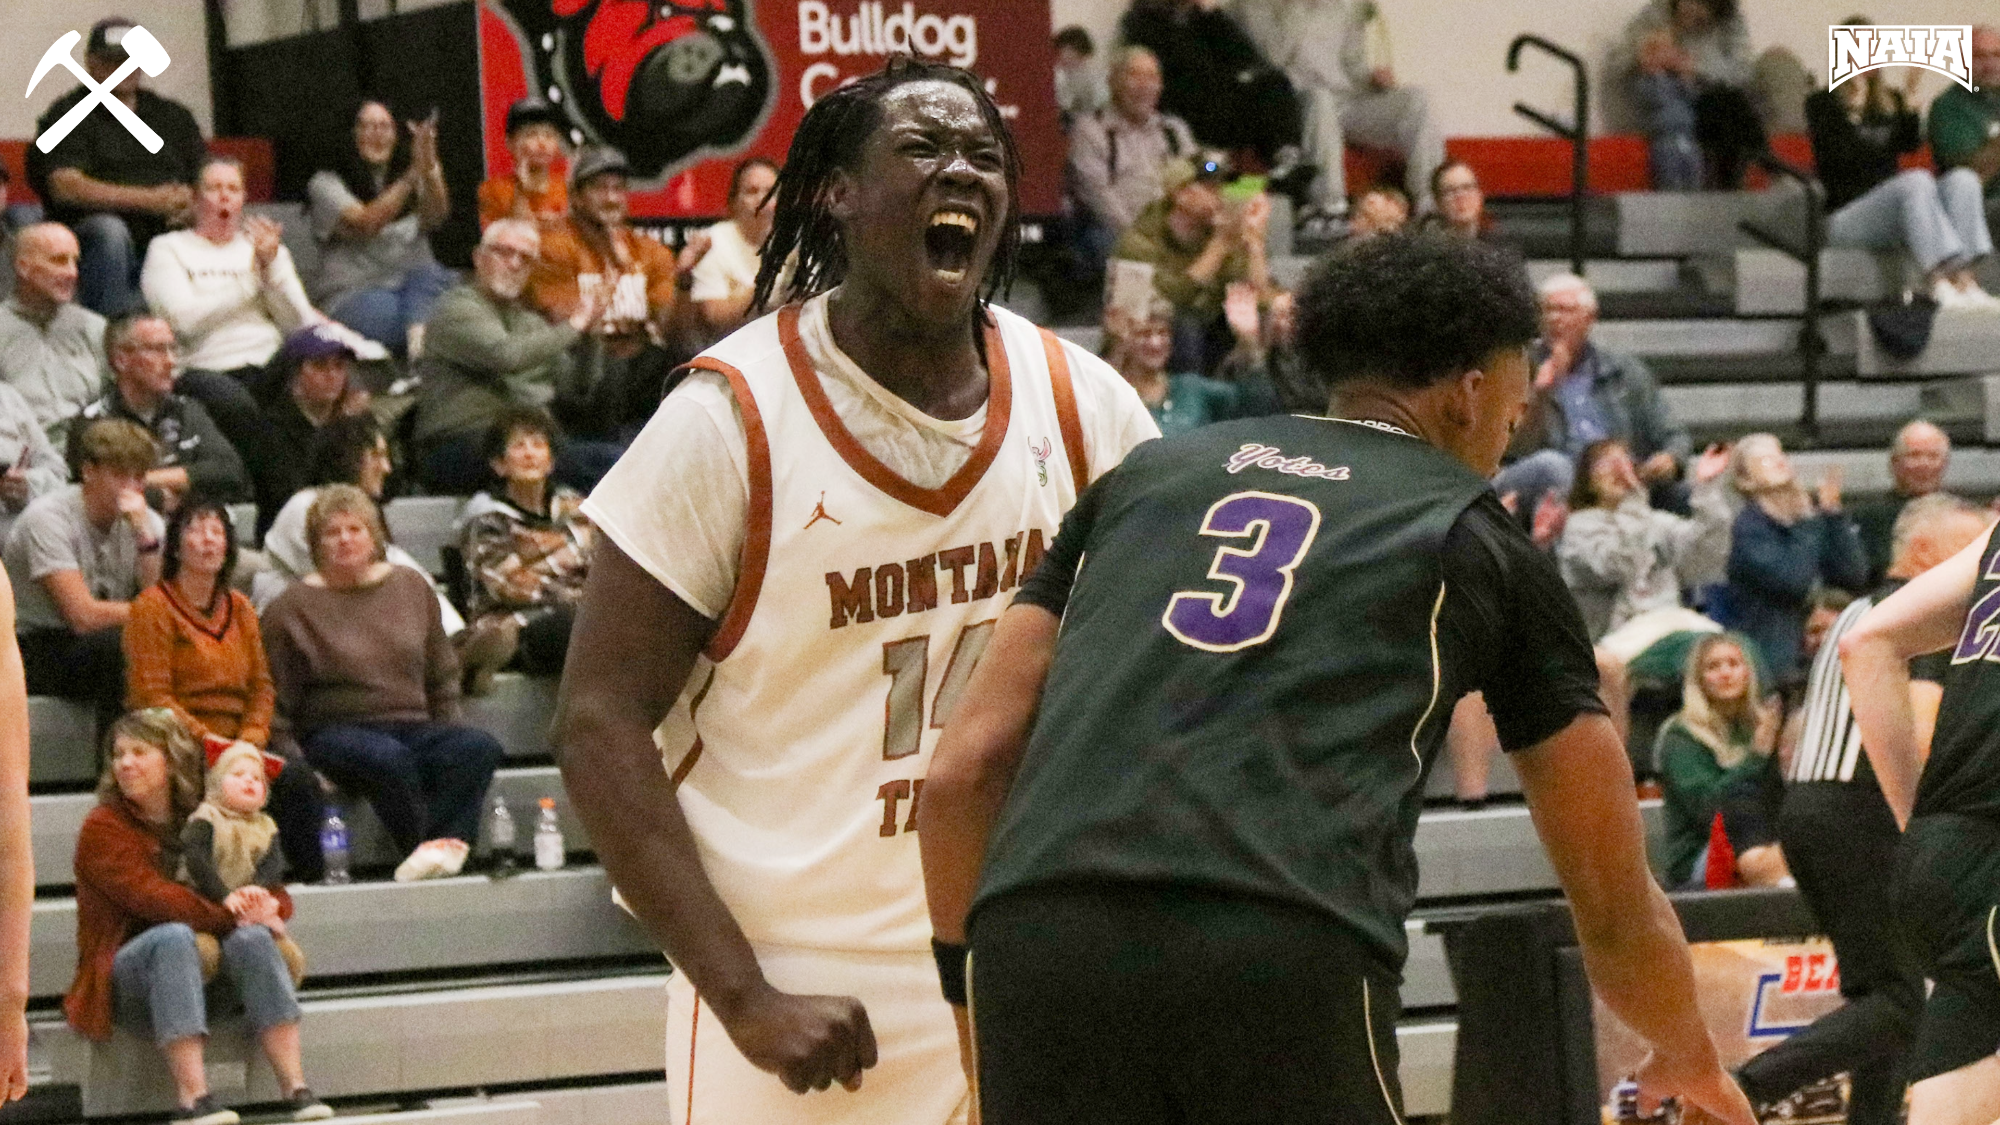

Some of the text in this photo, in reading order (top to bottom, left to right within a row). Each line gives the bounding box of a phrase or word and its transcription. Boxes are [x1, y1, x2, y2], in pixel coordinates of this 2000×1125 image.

[798, 0, 978, 69] Bulldog
[1223, 443, 1350, 480] Yotes
[1162, 491, 1321, 652] 3
